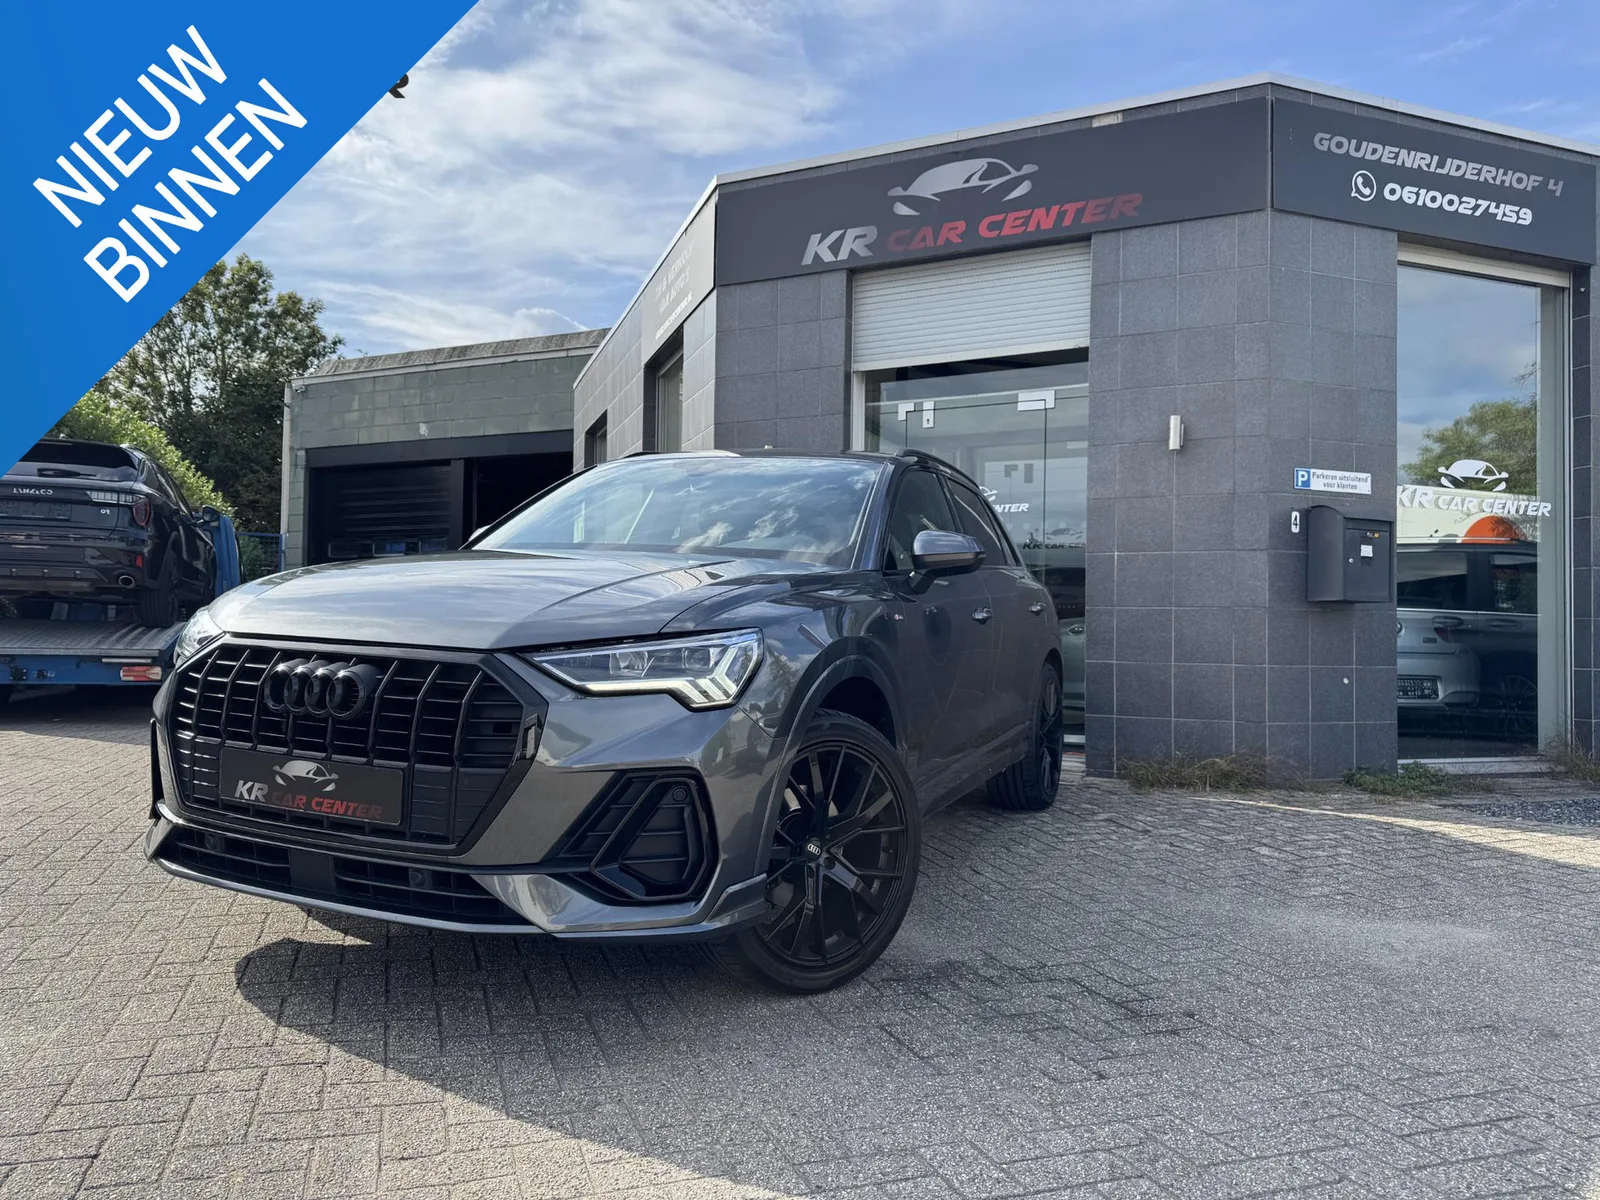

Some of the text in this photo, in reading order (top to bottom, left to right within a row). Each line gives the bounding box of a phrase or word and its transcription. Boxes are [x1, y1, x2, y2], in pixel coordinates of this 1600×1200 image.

[1313, 131, 1564, 197] GOUDENRIJDERHOF 4
[1383, 182, 1533, 226] 0610027459
[801, 193, 1143, 265] KR CAR CENTER
[1297, 470, 1369, 487] P Parkeren uitsluitend
[1336, 482, 1358, 490] klanten
[992, 503, 1030, 513] NTER
[1397, 486, 1552, 517] KR CAR CENTER
[1292, 514, 1299, 530] 4
[234, 780, 383, 820] KR CAR CENTER
